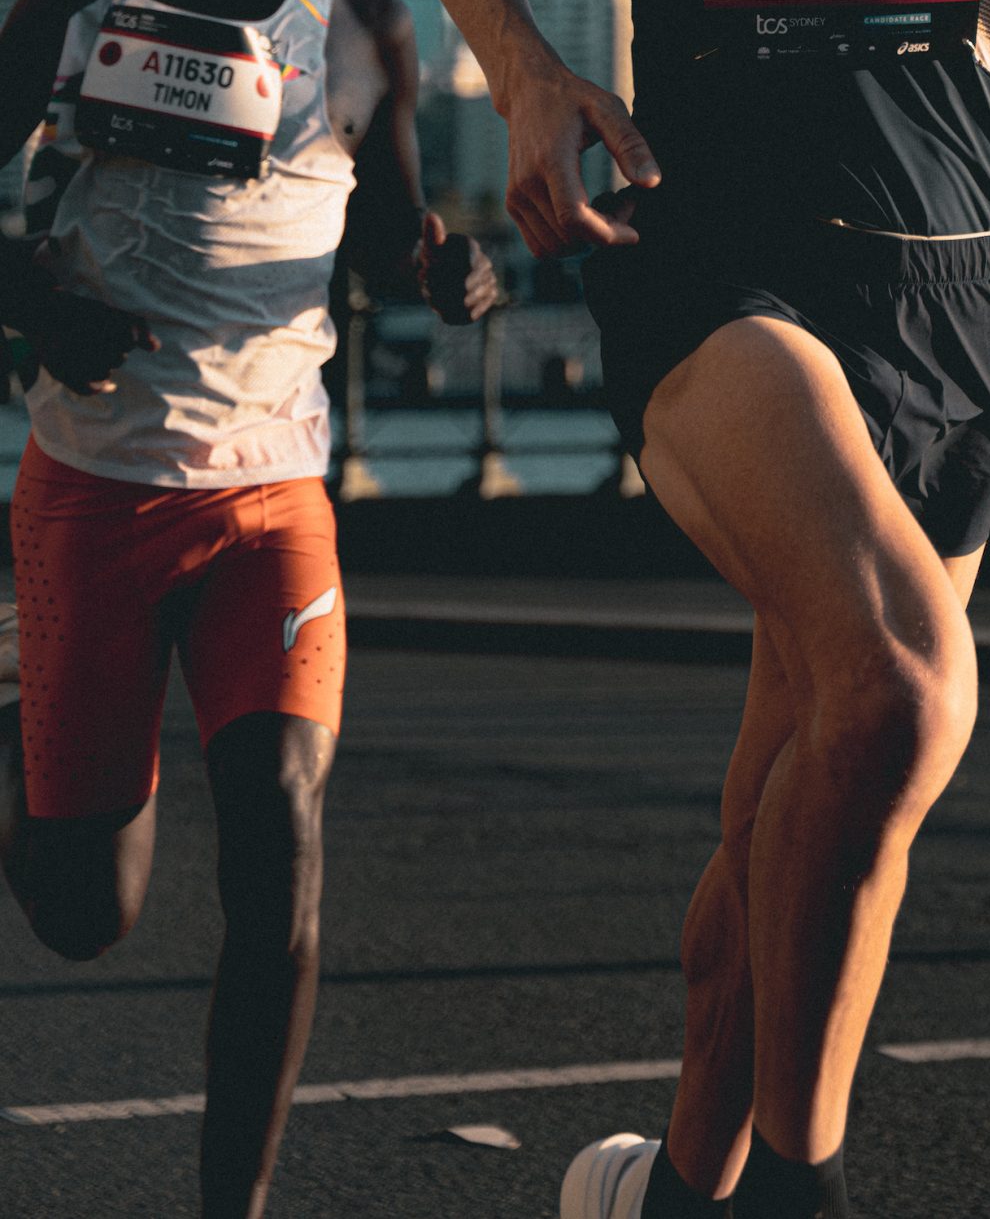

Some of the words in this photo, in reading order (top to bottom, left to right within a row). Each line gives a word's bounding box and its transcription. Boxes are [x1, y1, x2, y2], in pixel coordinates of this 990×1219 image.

[756, 14, 788, 34] tcs
[789, 17, 826, 28] SYDNEY
[142, 50, 234, 89] A11630
[153, 82, 212, 112] TIMON
